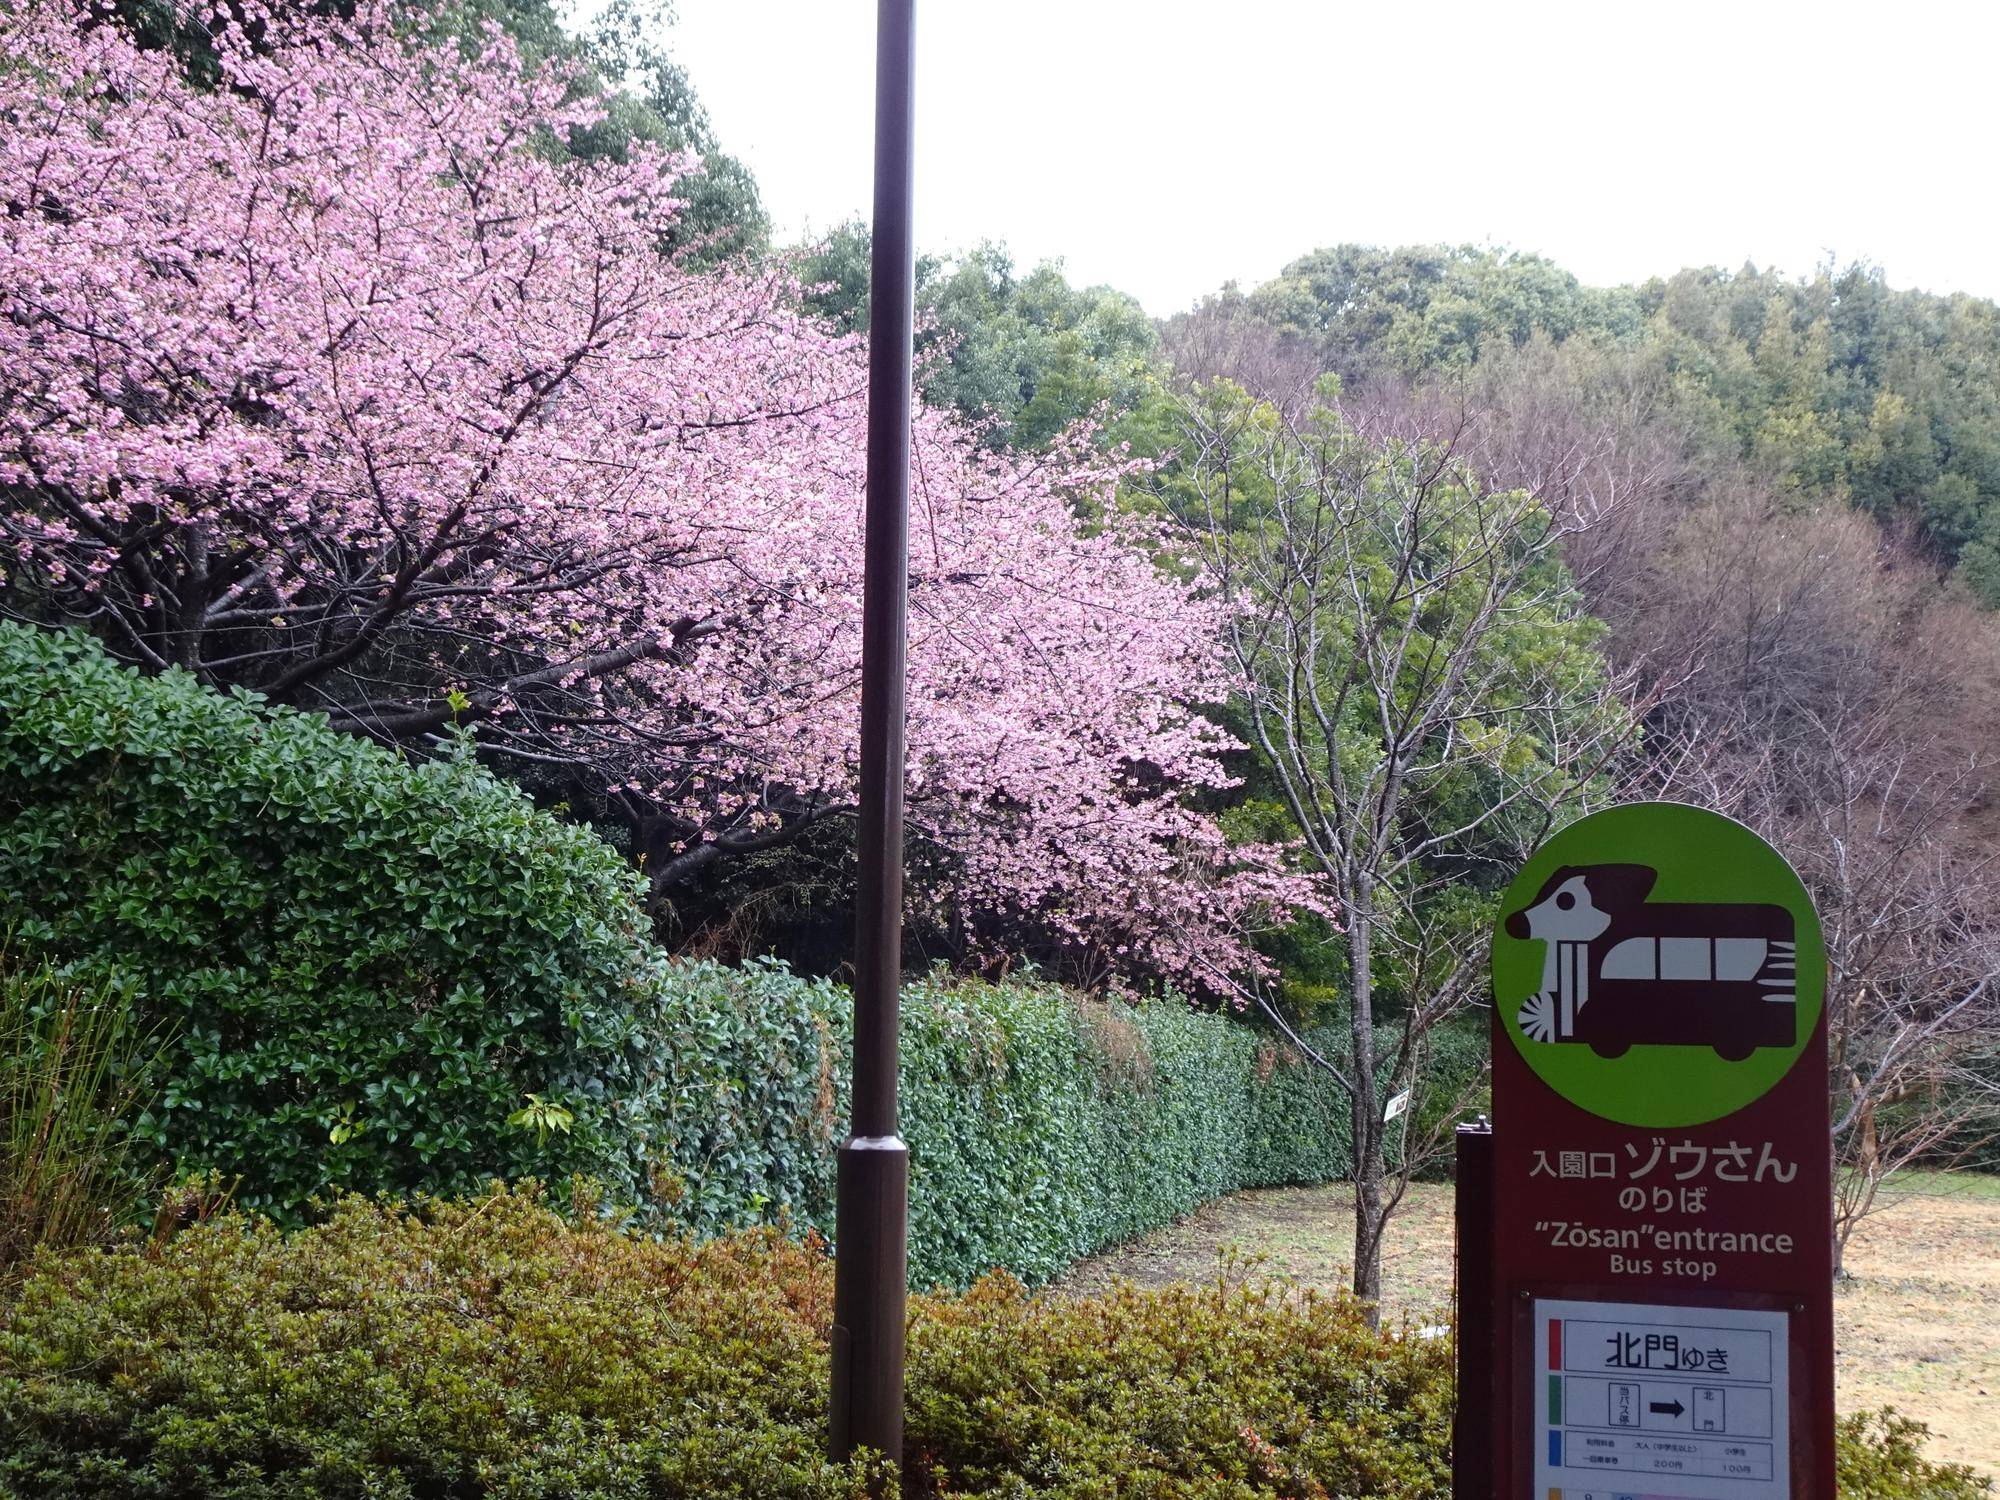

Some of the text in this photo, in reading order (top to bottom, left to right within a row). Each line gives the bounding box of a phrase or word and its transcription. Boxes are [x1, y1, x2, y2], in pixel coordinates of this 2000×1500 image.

[1529, 1137, 1798, 1183] 入園口 ゾウさん
[1618, 1186, 1708, 1214] のりば
[1610, 1254, 1718, 1282] Bus stop
[1605, 1331, 1729, 1371] 北門ゆき
